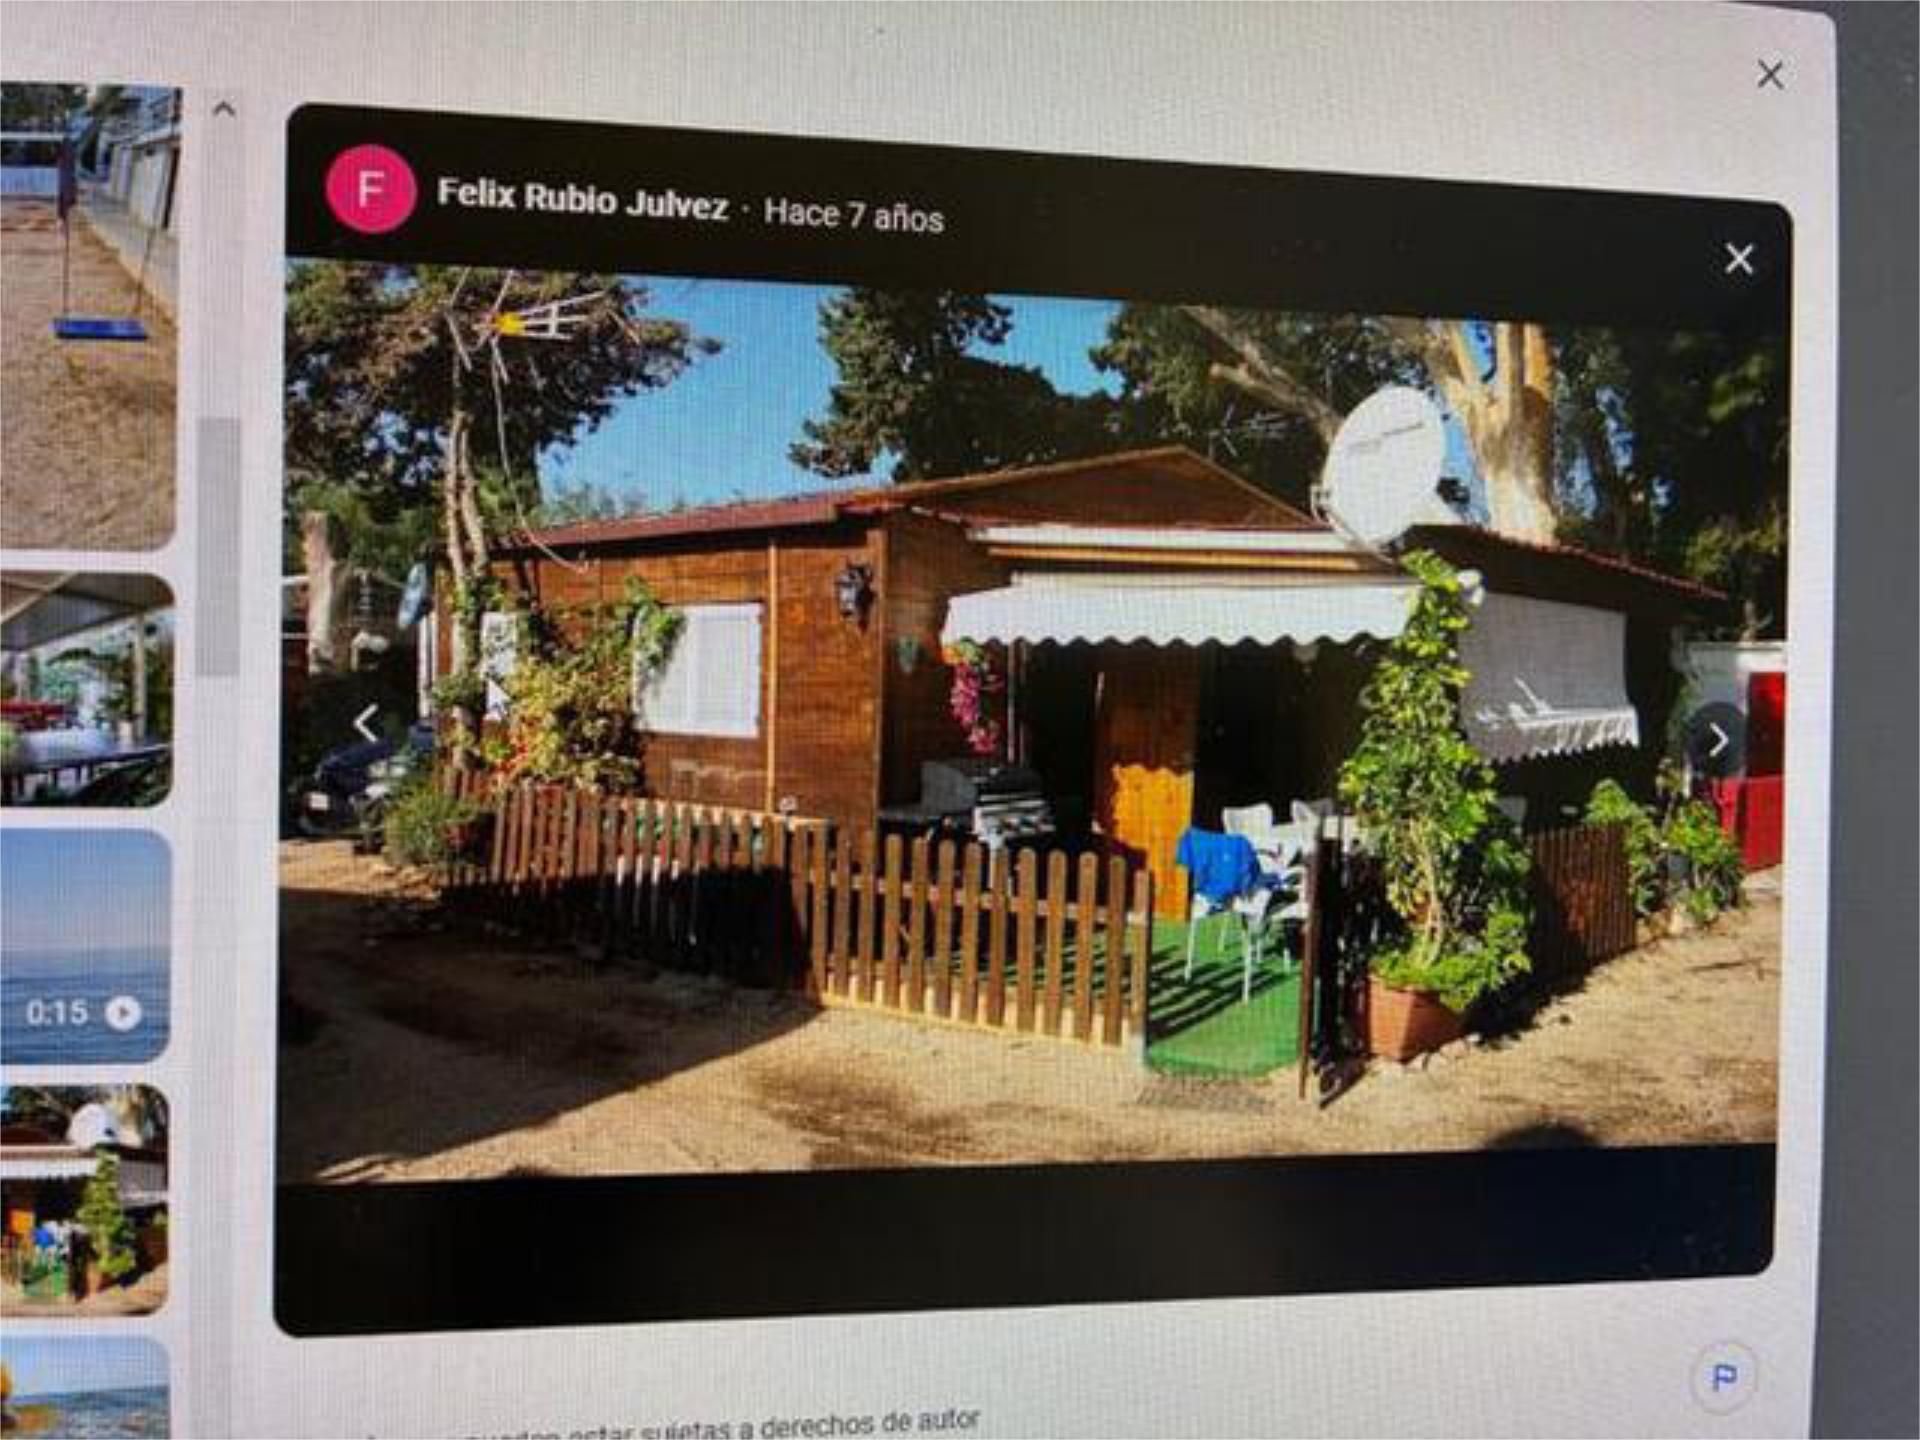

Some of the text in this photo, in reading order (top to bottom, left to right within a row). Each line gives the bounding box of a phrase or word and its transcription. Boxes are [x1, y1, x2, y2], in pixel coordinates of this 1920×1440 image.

[358, 169, 385, 209] F
[436, 176, 945, 233] Felix Rubio Julvez Hace 7 años
[26, 998, 90, 1026] 0:15
[739, 1415, 754, 1440] a
[760, 1409, 875, 1440] derechos
[881, 1406, 912, 1432] de
[916, 1403, 981, 1432] autor
